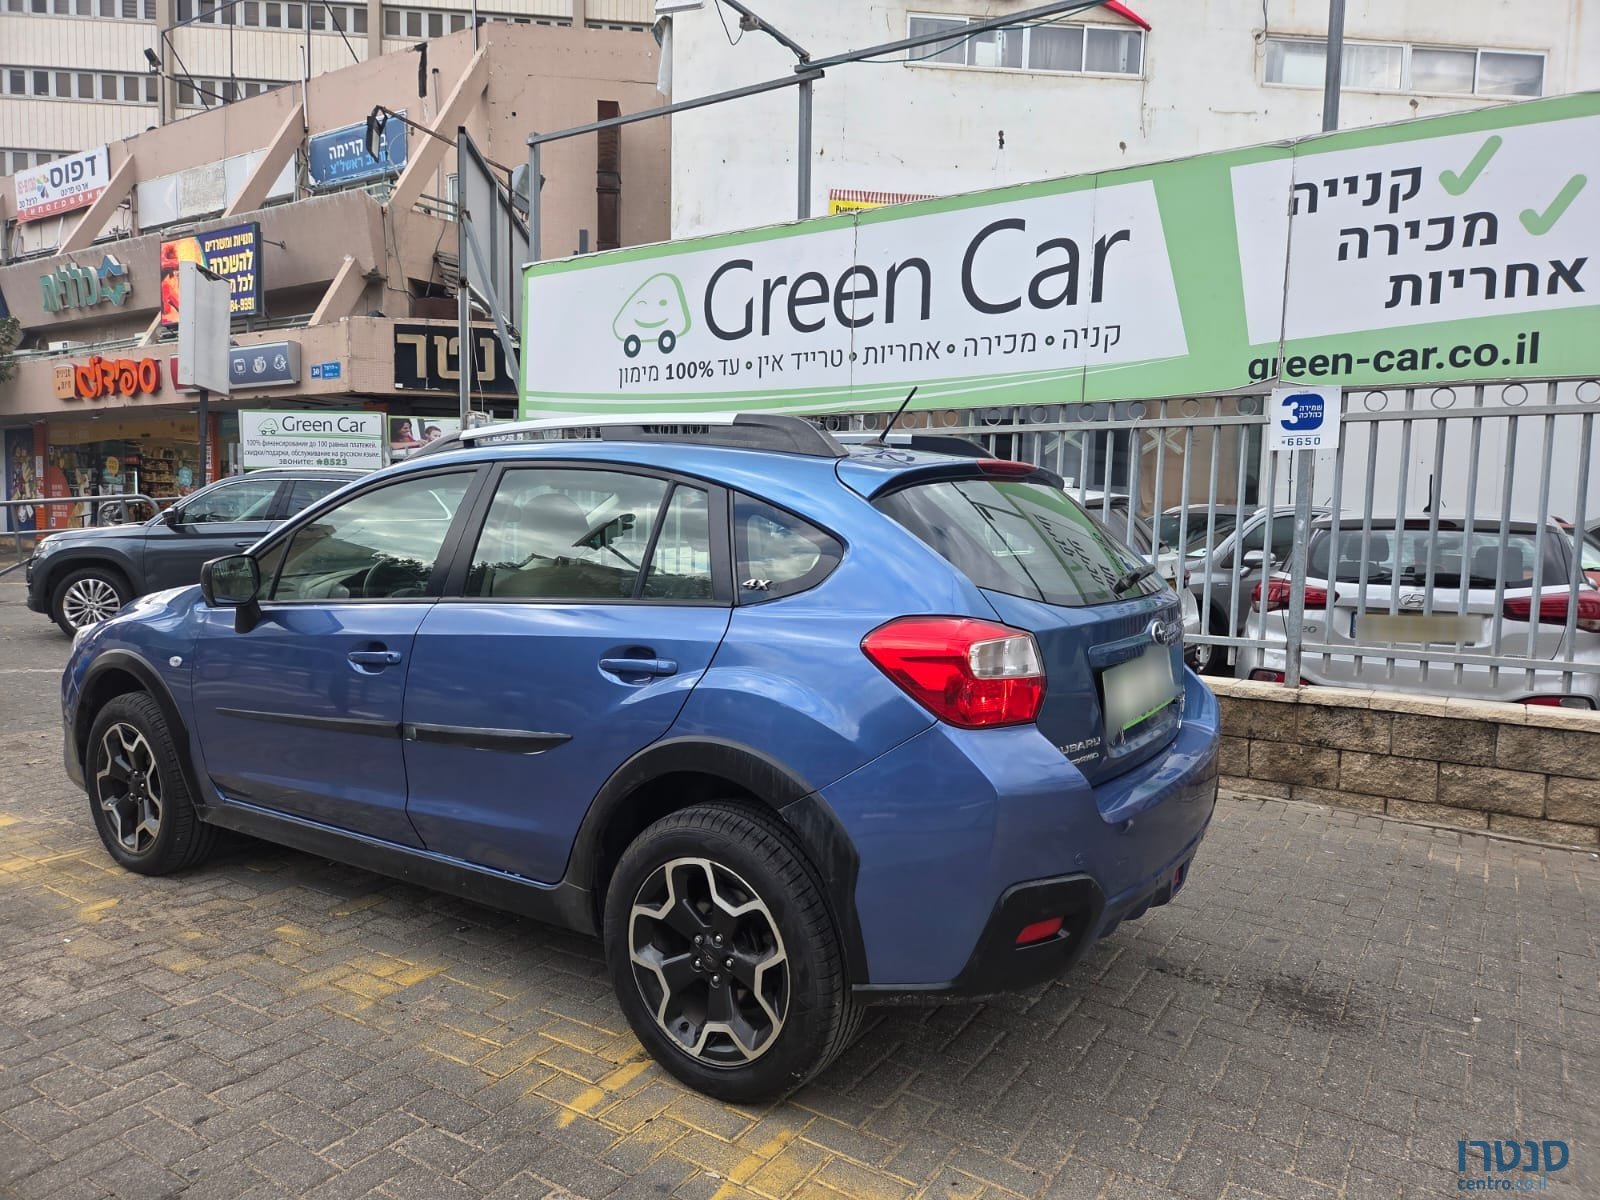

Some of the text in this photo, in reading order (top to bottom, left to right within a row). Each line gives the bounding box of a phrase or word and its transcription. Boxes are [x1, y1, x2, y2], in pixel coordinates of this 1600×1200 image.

[50, 155, 97, 189] דפוס
[1287, 166, 1423, 217] קנייה
[1337, 211, 1499, 262] מכירה
[40, 262, 99, 314] כללית
[236, 272, 254, 292] לכל
[703, 217, 1131, 342] Green Car
[1384, 256, 1589, 309] אחריות
[617, 324, 1121, 389] קניה מכירה אחריות טרייד אין עד 100% מימון
[1248, 331, 1540, 382] green-car.co.il
[282, 416, 367, 433] Green Car
[1298, 410, 1322, 419] כהלכה
[1299, 404, 1322, 412] שמירה
[318, 440, 328, 448] 100
[1059, 736, 1101, 754] UBARU
